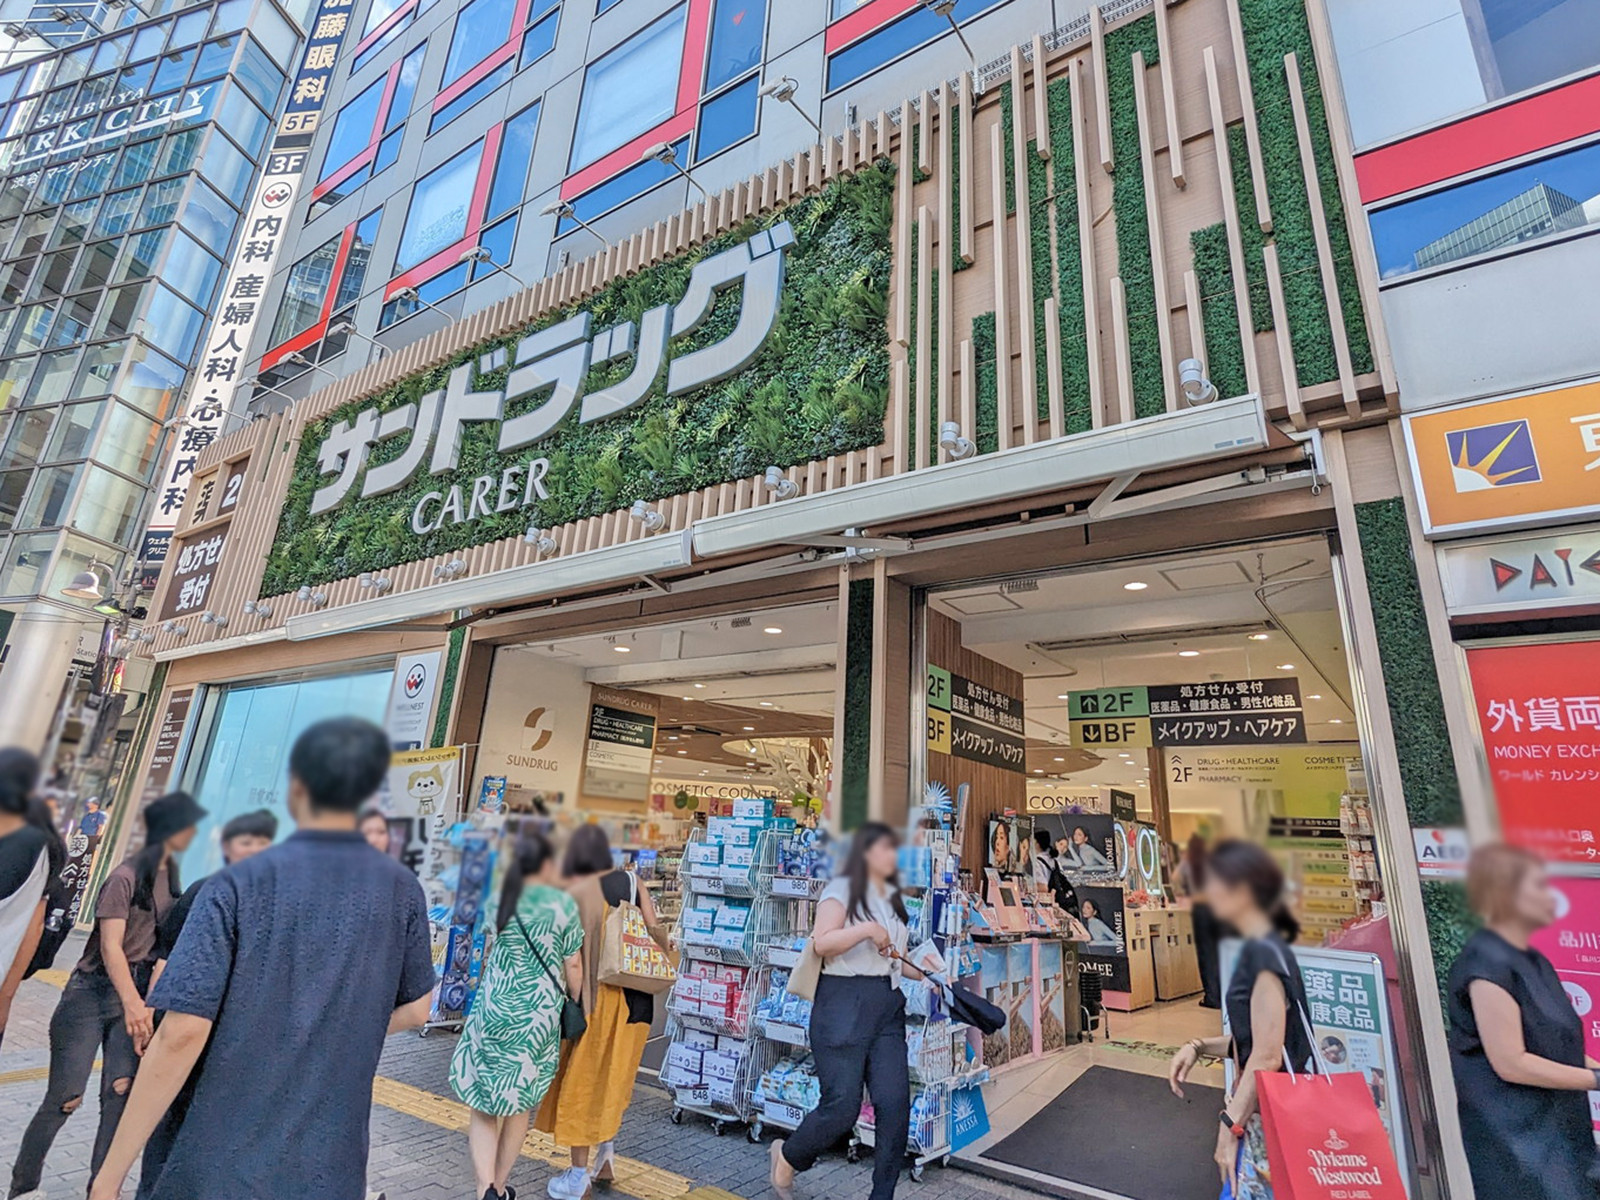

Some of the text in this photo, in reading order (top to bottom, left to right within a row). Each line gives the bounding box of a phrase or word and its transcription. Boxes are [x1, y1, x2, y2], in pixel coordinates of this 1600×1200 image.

[35, 87, 144, 129] SHIBUYA
[105, 86, 212, 130] CITY
[285, 113, 317, 130] 5F
[271, 154, 303, 174] 3F
[242, 215, 283, 263] 内科
[310, 220, 798, 516] サンドラッグ
[411, 457, 551, 535] CARER
[175, 573, 211, 613] 受付
[927, 674, 946, 699] 2F
[967, 681, 1010, 711] 処方せん受付
[1180, 681, 1264, 698] 処方せん受付
[1103, 692, 1134, 713] 2F
[1150, 695, 1296, 713] 医薬品・健康食品・男性化粧品
[927, 717, 946, 742] BF
[1105, 722, 1136, 743] BF
[1158, 717, 1297, 741] メイクアップ・ヘアケア
[952, 728, 1024, 764] メイクアップ・ヘアケア
[1494, 745, 1551, 759] MONEY
[506, 754, 558, 772] SUNDRUG
[1197, 757, 1280, 766] DRUG HEALTHCARE
[1304, 756, 1346, 764] COSMETI
[1172, 766, 1194, 783] 2F
[1198, 775, 1242, 783] PHARMACY
[1550, 769, 1600, 781] カレンシ
[652, 782, 714, 797] OSMETIC
[70, 836, 87, 854] 薬
[707, 880, 722, 890] 548
[791, 881, 807, 890] 980
[1558, 930, 1600, 949] 品川
[1304, 969, 1369, 1006] 薬品
[1311, 1001, 1375, 1031] 康食品
[692, 1090, 709, 1100] 548
[786, 1107, 801, 1119] 198
[955, 1115, 977, 1136] ANESSA
[1308, 1148, 1368, 1167] Vivienne
[1308, 1166, 1383, 1186] Westwood
[1330, 1189, 1373, 1199] RED LABEL
